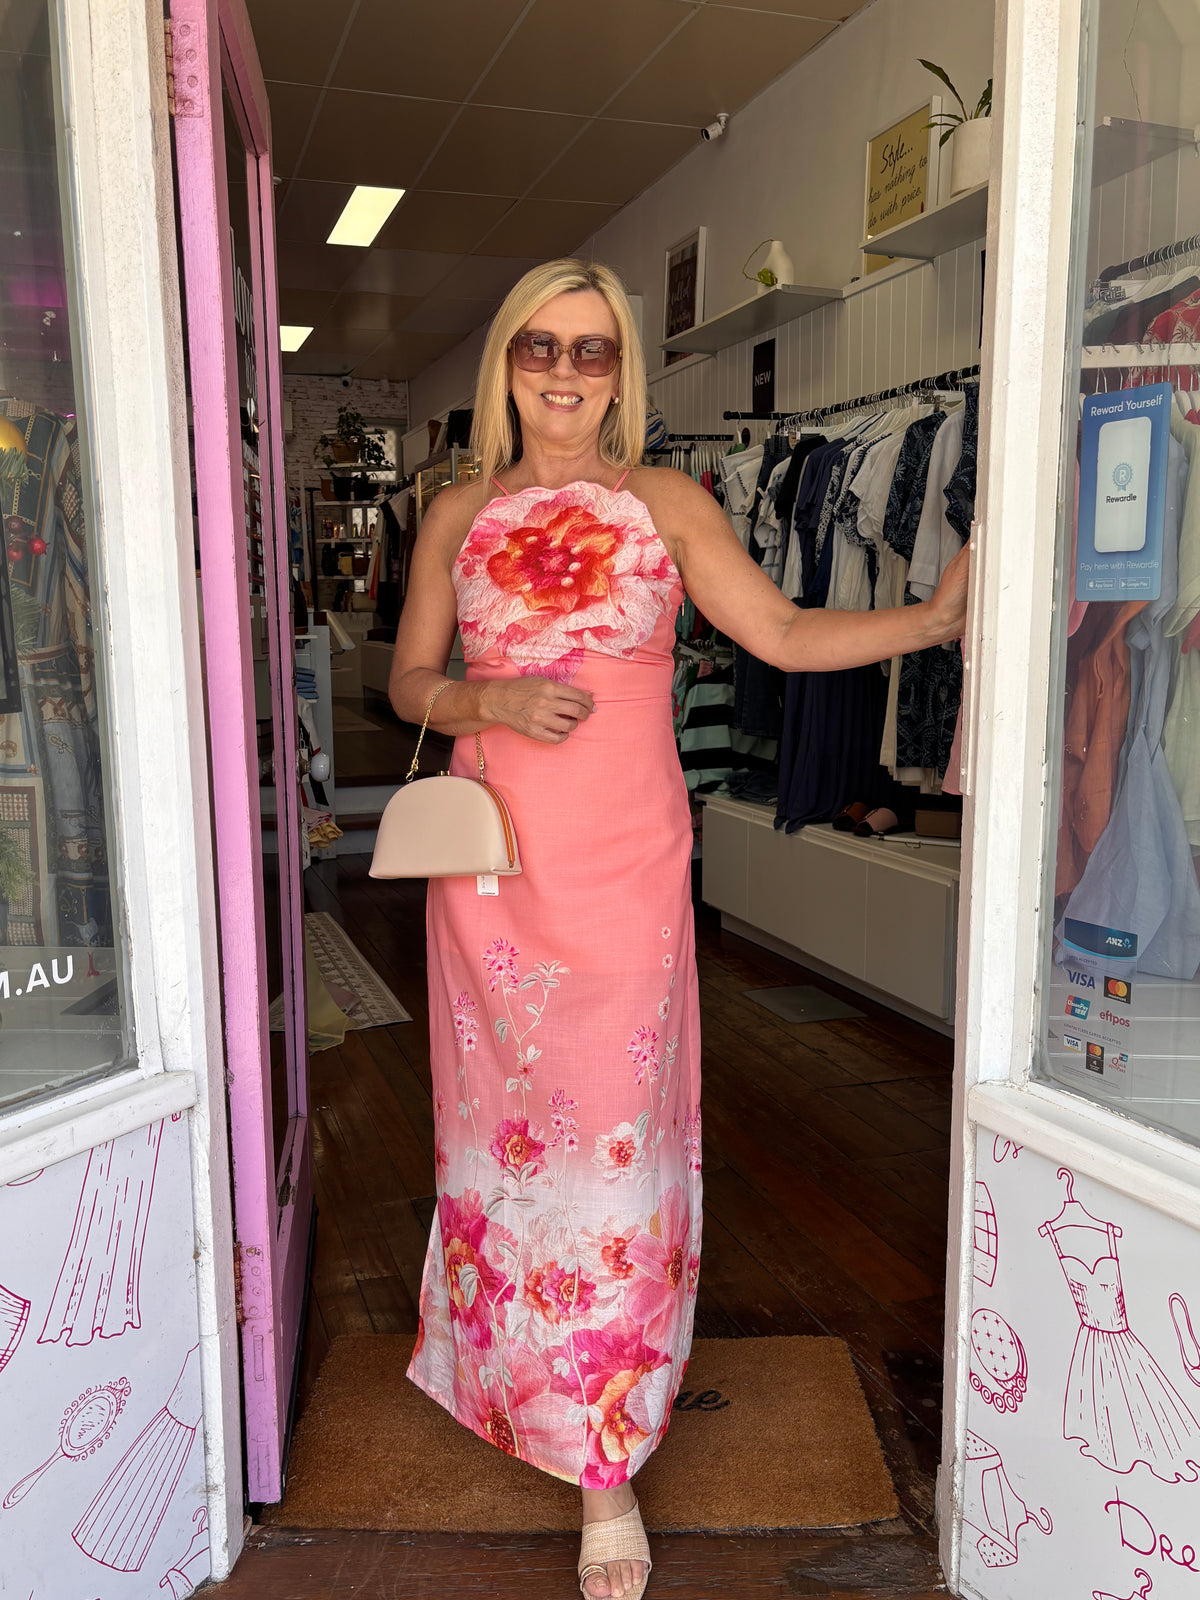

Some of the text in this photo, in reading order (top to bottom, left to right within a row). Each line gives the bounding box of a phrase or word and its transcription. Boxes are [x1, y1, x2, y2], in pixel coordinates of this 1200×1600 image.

[884, 164, 916, 193] nothing
[919, 155, 928, 169] to
[880, 195, 898, 222] with
[754, 370, 772, 387] NEW
[1090, 394, 1163, 417] Reward Yourself
[1105, 493, 1137, 503] Rewardle
[1080, 562, 1092, 572] Pay
[1110, 561, 1124, 569] with
[1126, 560, 1159, 569] Rewardle
[1105, 936, 1123, 947] ANZ
[1066, 968, 1096, 989] VISA
[1099, 1010, 1130, 1028] eftpos
[1066, 1037, 1079, 1048] VISA
